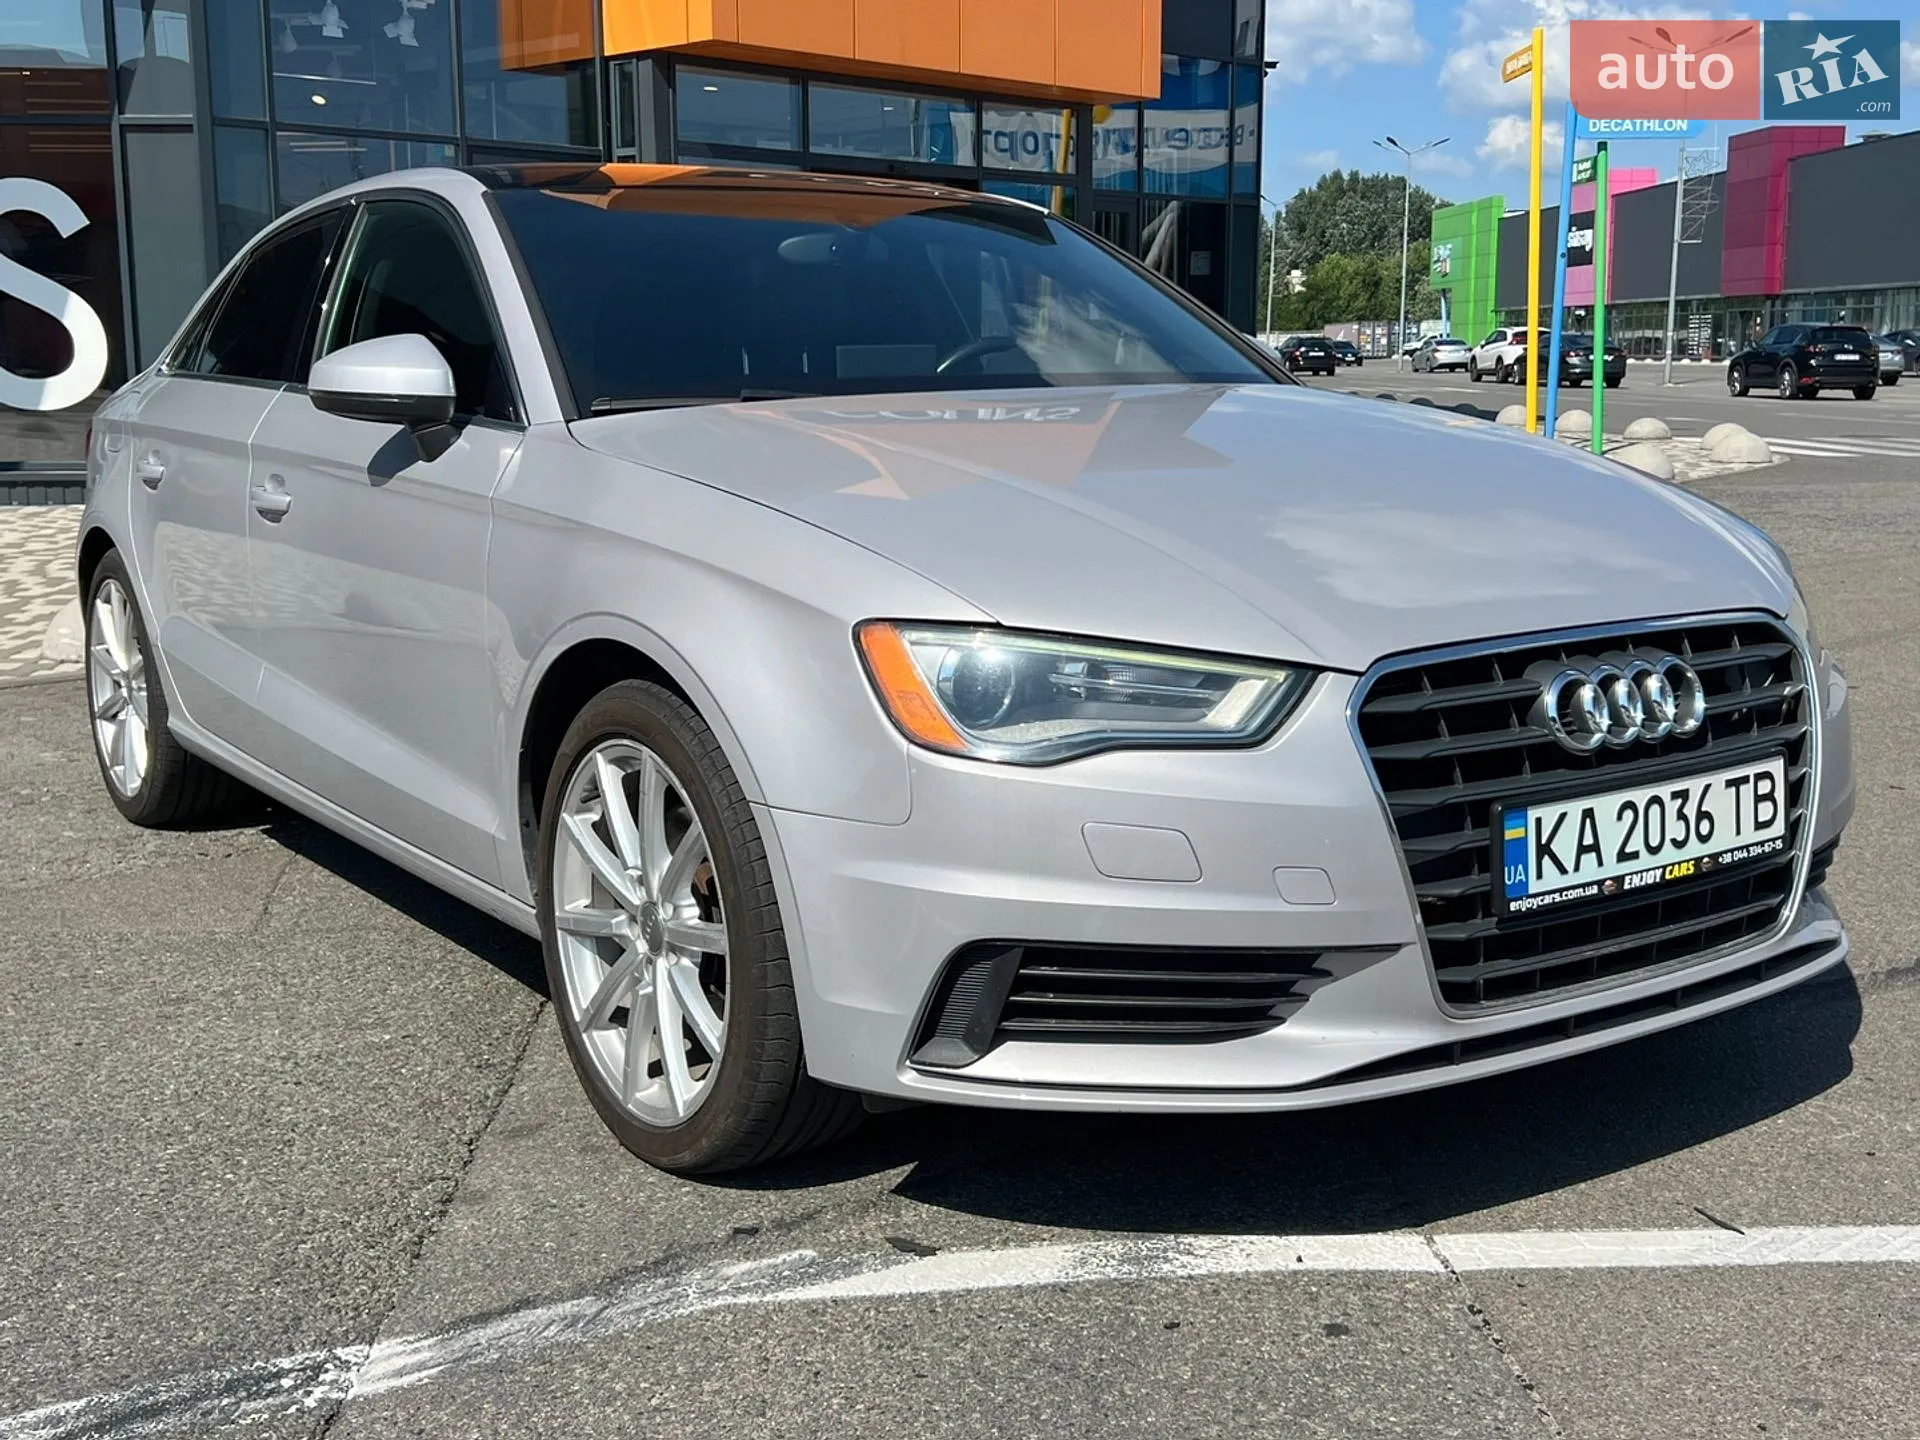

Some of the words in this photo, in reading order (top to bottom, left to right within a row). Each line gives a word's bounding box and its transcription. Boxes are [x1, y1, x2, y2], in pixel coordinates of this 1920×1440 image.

[1588, 117, 1689, 132] DECATHLON
[1534, 806, 1605, 881] KA
[1615, 782, 1715, 864] 2036
[1724, 769, 1779, 837] TB
[1504, 863, 1526, 885] UA
[1509, 884, 1599, 912] enjoycars.com.ua
[1623, 867, 1664, 890] ENJOY
[1664, 859, 1695, 880] CARS
[1733, 848, 1748, 861] 044
